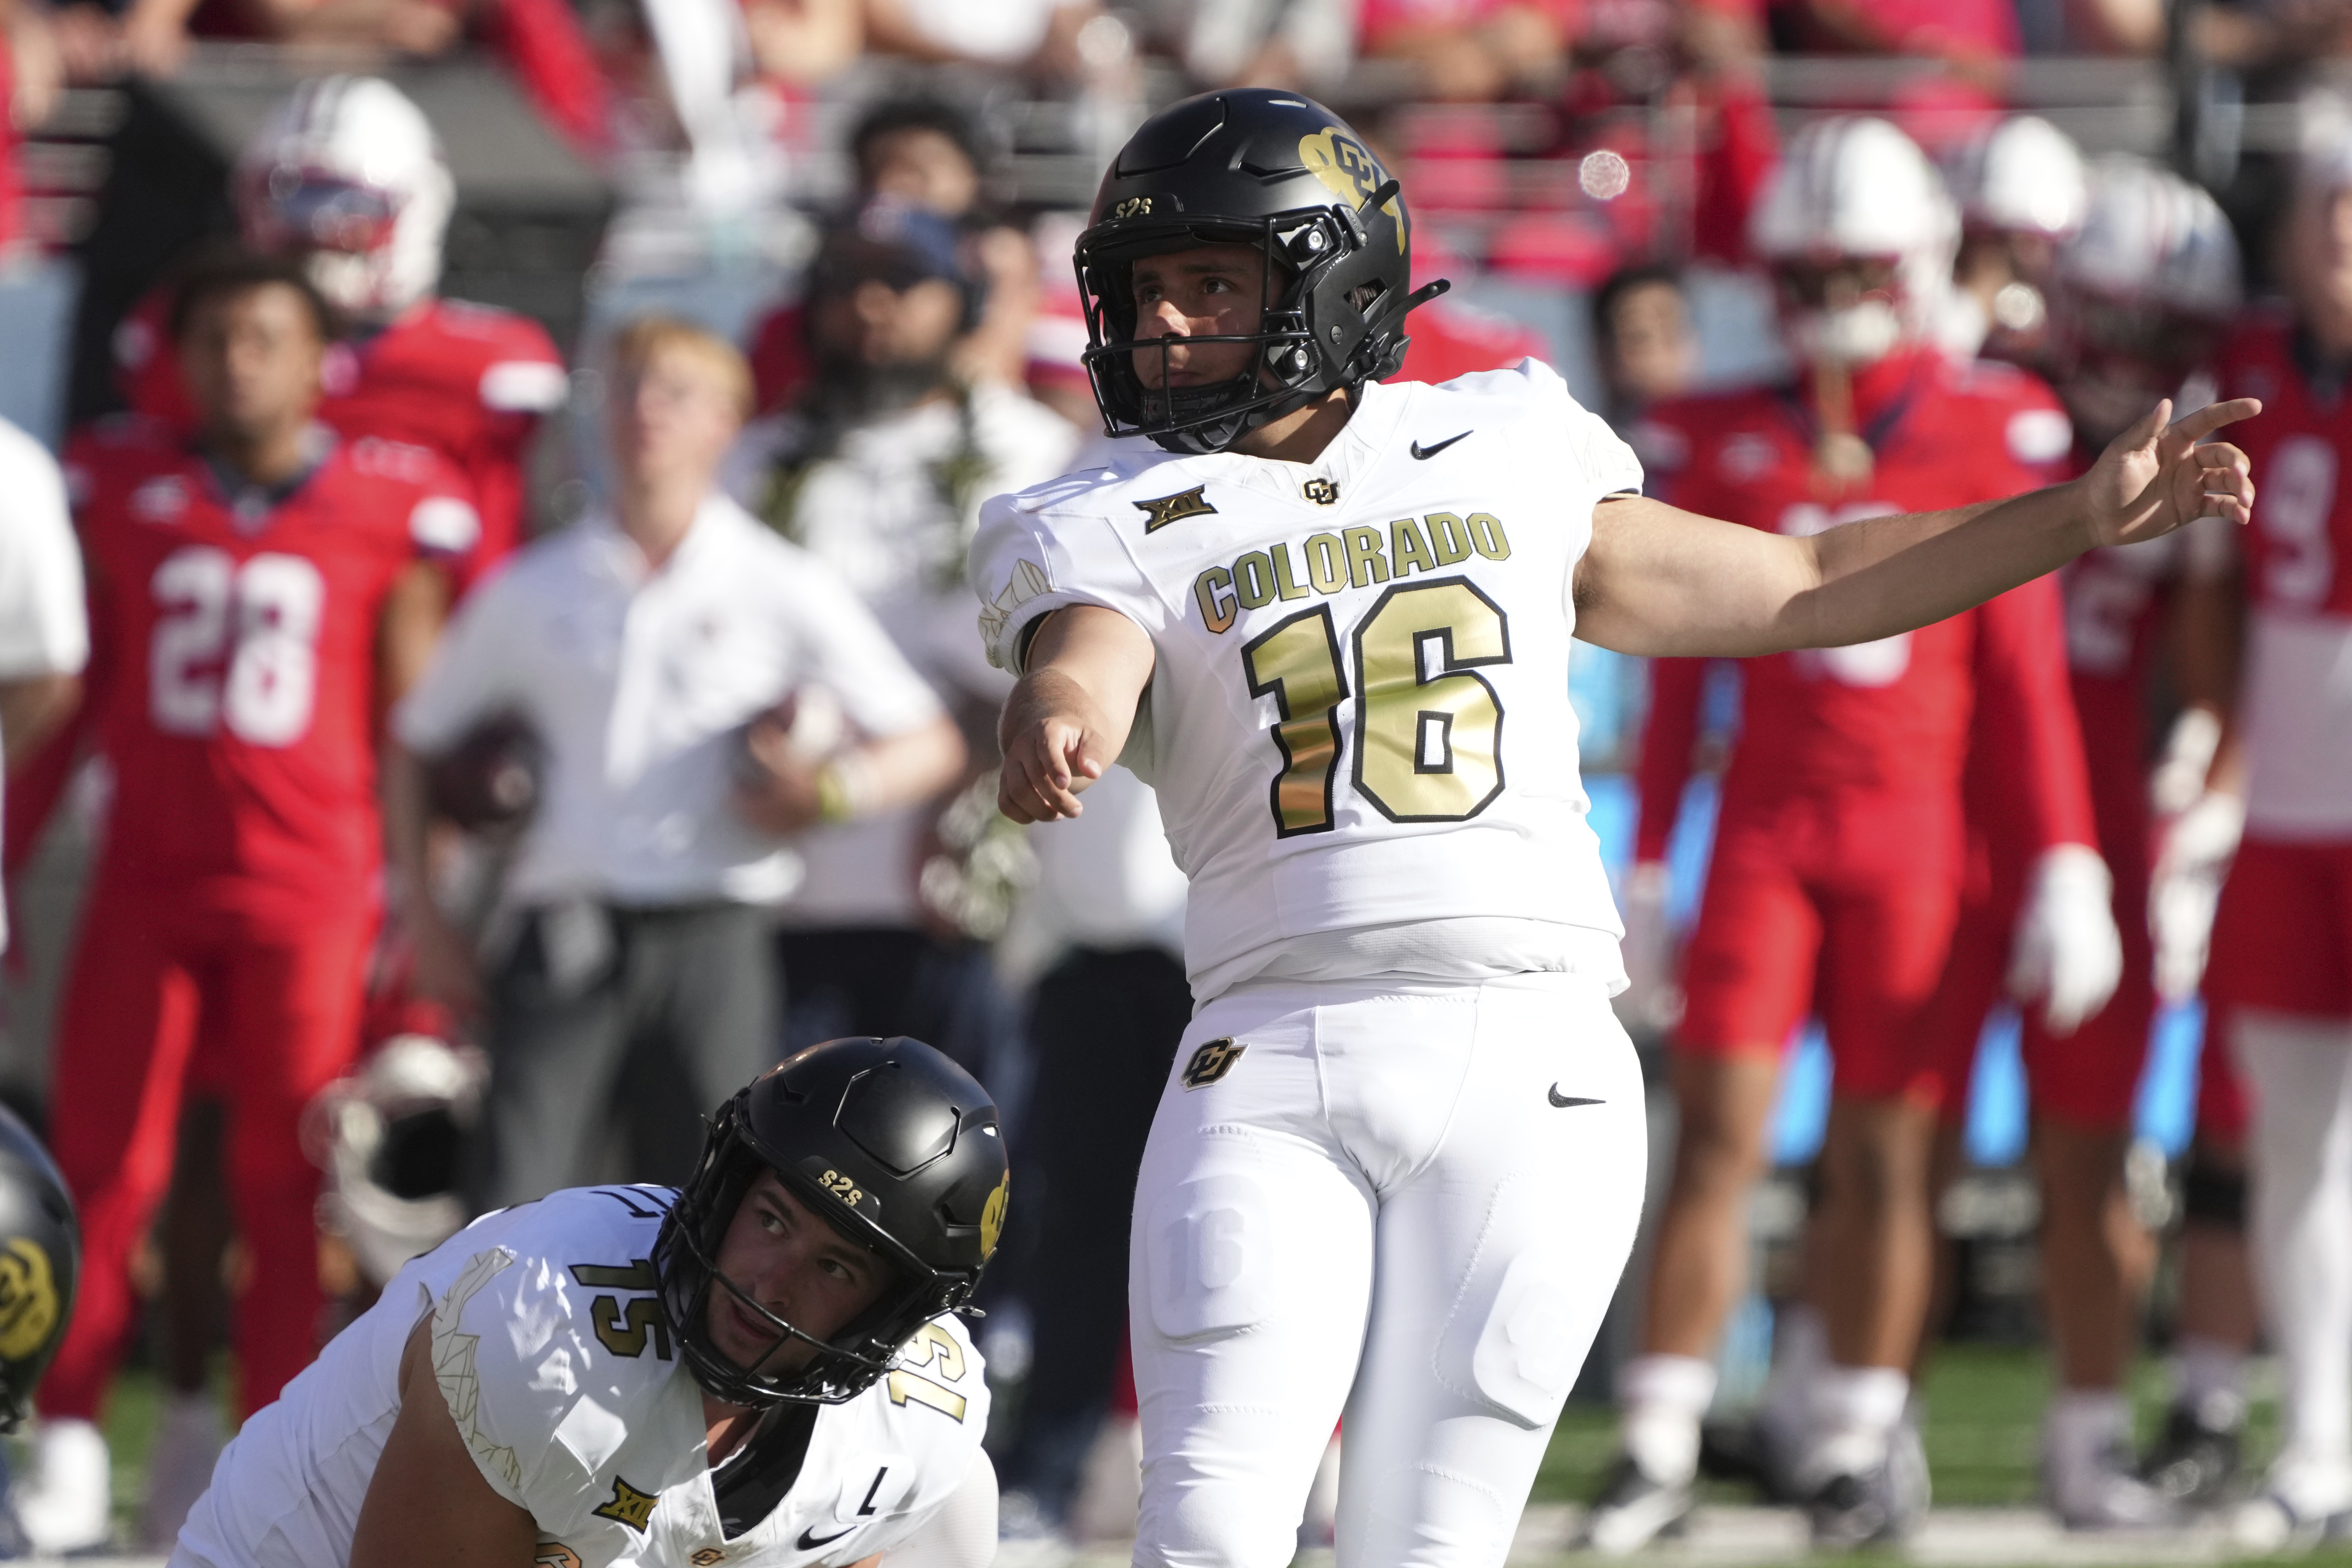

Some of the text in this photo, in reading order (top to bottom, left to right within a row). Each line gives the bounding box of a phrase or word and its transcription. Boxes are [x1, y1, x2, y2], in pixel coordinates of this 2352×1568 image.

[1115, 197, 1152, 219] S2S
[1131, 484, 1219, 535] XII
[1301, 478, 1339, 505] CU
[1194, 512, 1511, 634] COLORADO
[149, 543, 326, 749] 28
[1241, 574, 1513, 840] 16
[1179, 1035, 1250, 1092] CU
[818, 1170, 862, 1206] S2S
[567, 1259, 672, 1362] 15
[887, 1322, 967, 1425] 15
[591, 1475, 662, 1535] XII
